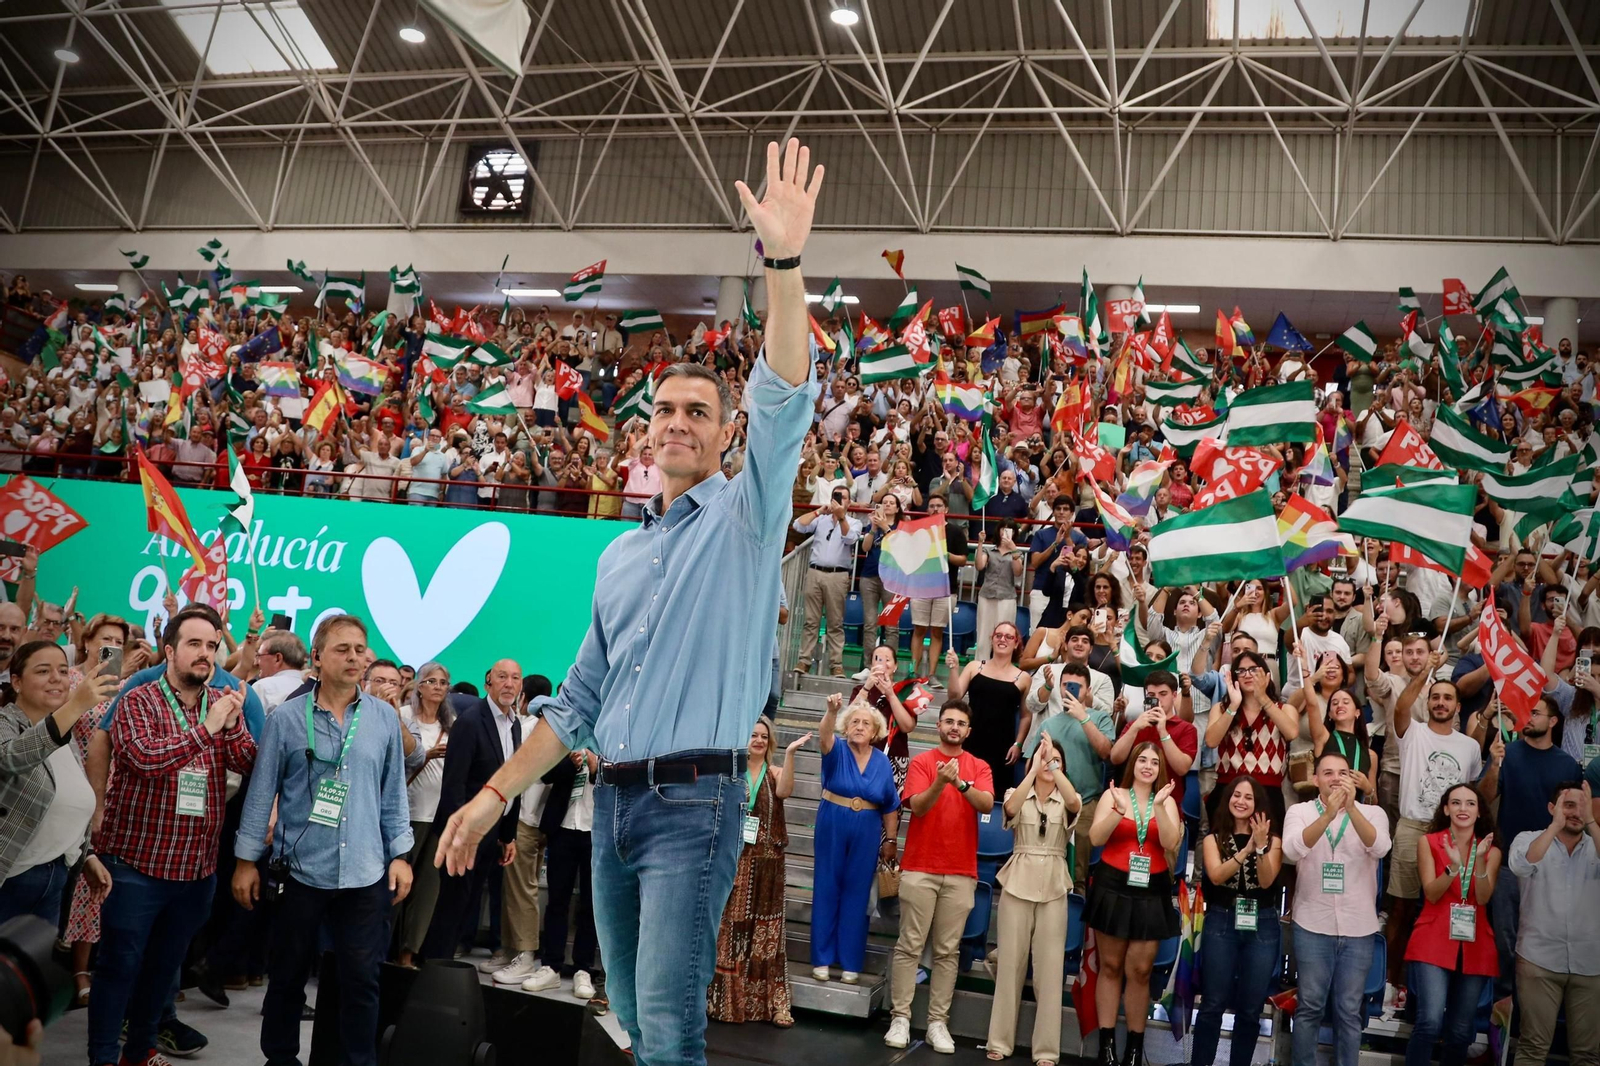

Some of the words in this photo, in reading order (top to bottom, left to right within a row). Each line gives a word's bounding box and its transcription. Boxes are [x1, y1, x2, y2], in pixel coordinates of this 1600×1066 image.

[1400, 430, 1445, 471] PSO
[129, 565, 246, 647] qe
[180, 786, 204, 795] MÁLAGA
[181, 780, 205, 789] 14.09.25
[320, 785, 346, 797] 14.09.25
[317, 791, 343, 804] MÁLAGA
